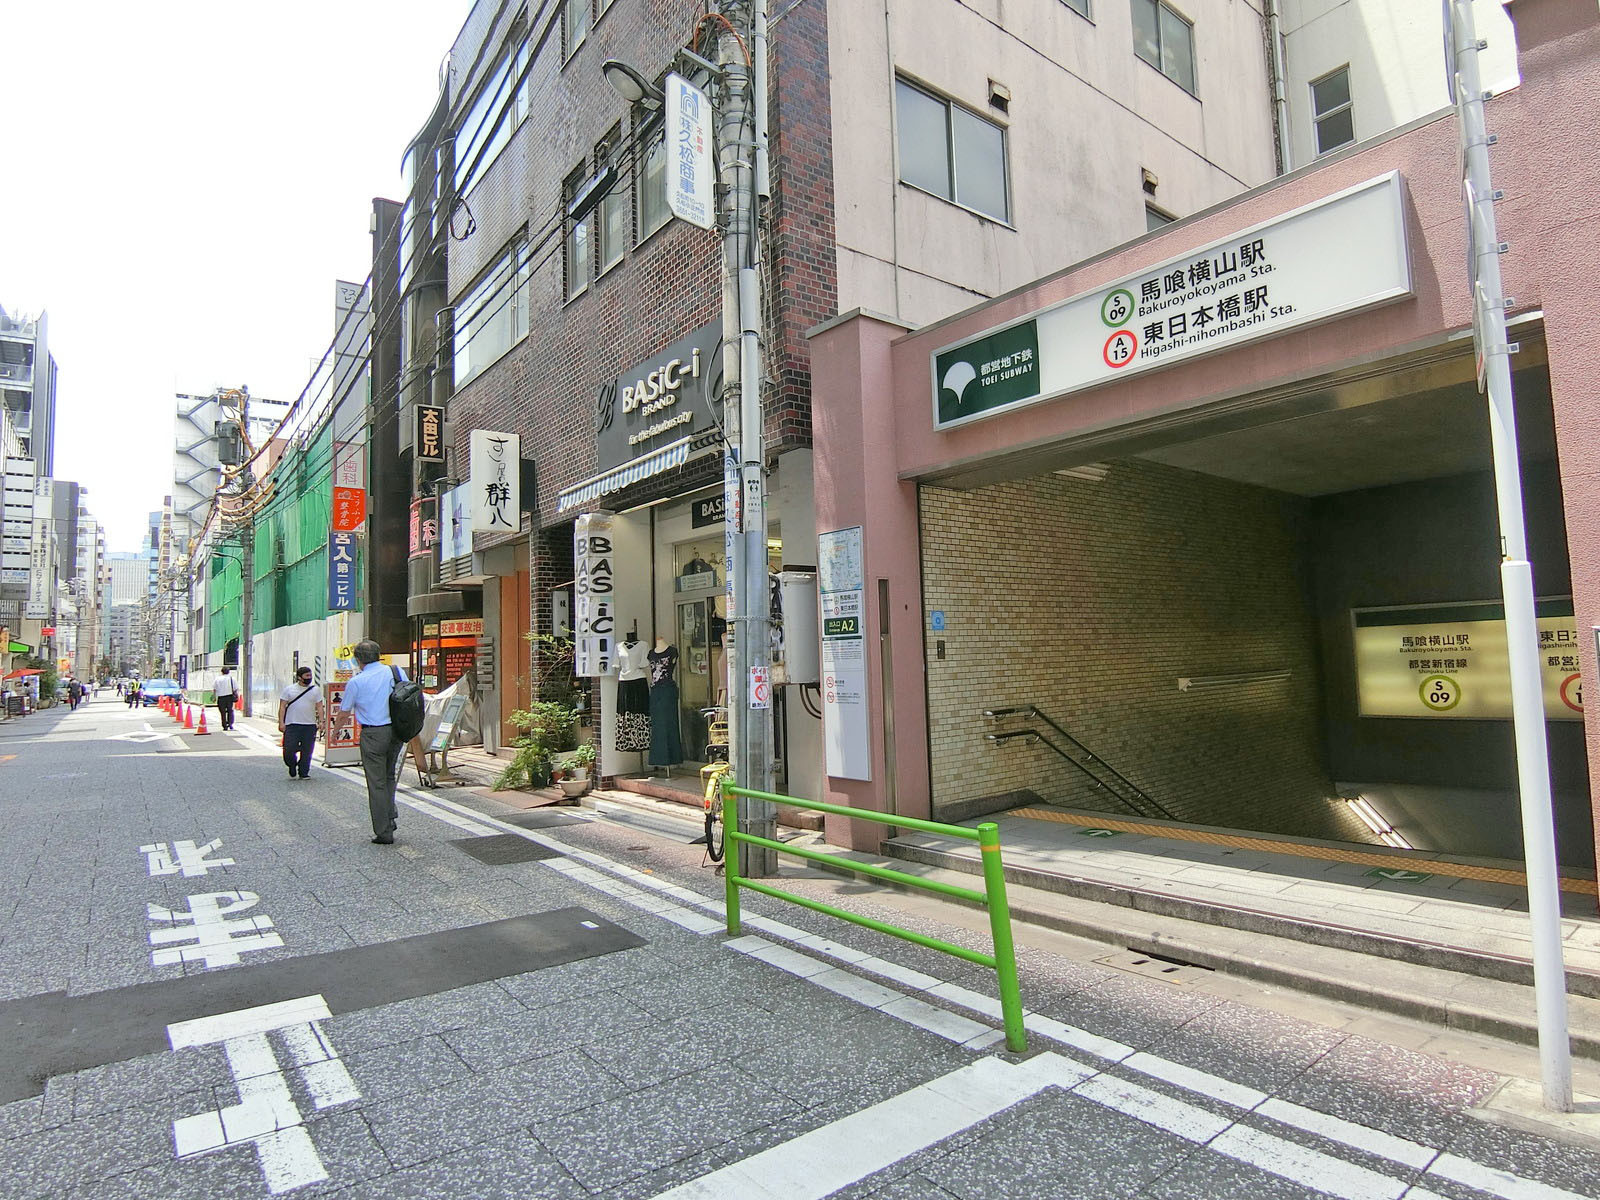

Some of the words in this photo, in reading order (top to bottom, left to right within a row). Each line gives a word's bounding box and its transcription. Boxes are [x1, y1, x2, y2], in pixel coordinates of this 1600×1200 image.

[1141, 239, 1266, 304] 馬喰横山駅
[1138, 273, 1246, 318] Bakuroyokoyama
[1250, 263, 1277, 278] Sta.
[1113, 296, 1121, 307] S
[1109, 306, 1126, 321] 09
[1143, 285, 1270, 346] 東日本橋駅
[1141, 311, 1266, 359] Higashi-nihombashi
[1270, 304, 1297, 319] Sta.
[1115, 337, 1125, 348] A
[1113, 347, 1128, 361] 15
[981, 348, 1033, 376] 都営地下鉄
[981, 374, 998, 387] TOEI
[1000, 362, 1033, 381] SUBWAY
[642, 394, 676, 417] BRAND
[423, 409, 439, 456] 太田ビル
[333, 533, 353, 608] 宮入第二ビル
[441, 620, 485, 634] 交通事故治
[841, 619, 855, 632] A2
[1402, 634, 1470, 647] 馬喰横山駅
[1409, 658, 1468, 669] 都営新宿線
[1435, 681, 1443, 691] S
[1430, 692, 1450, 703] 09
